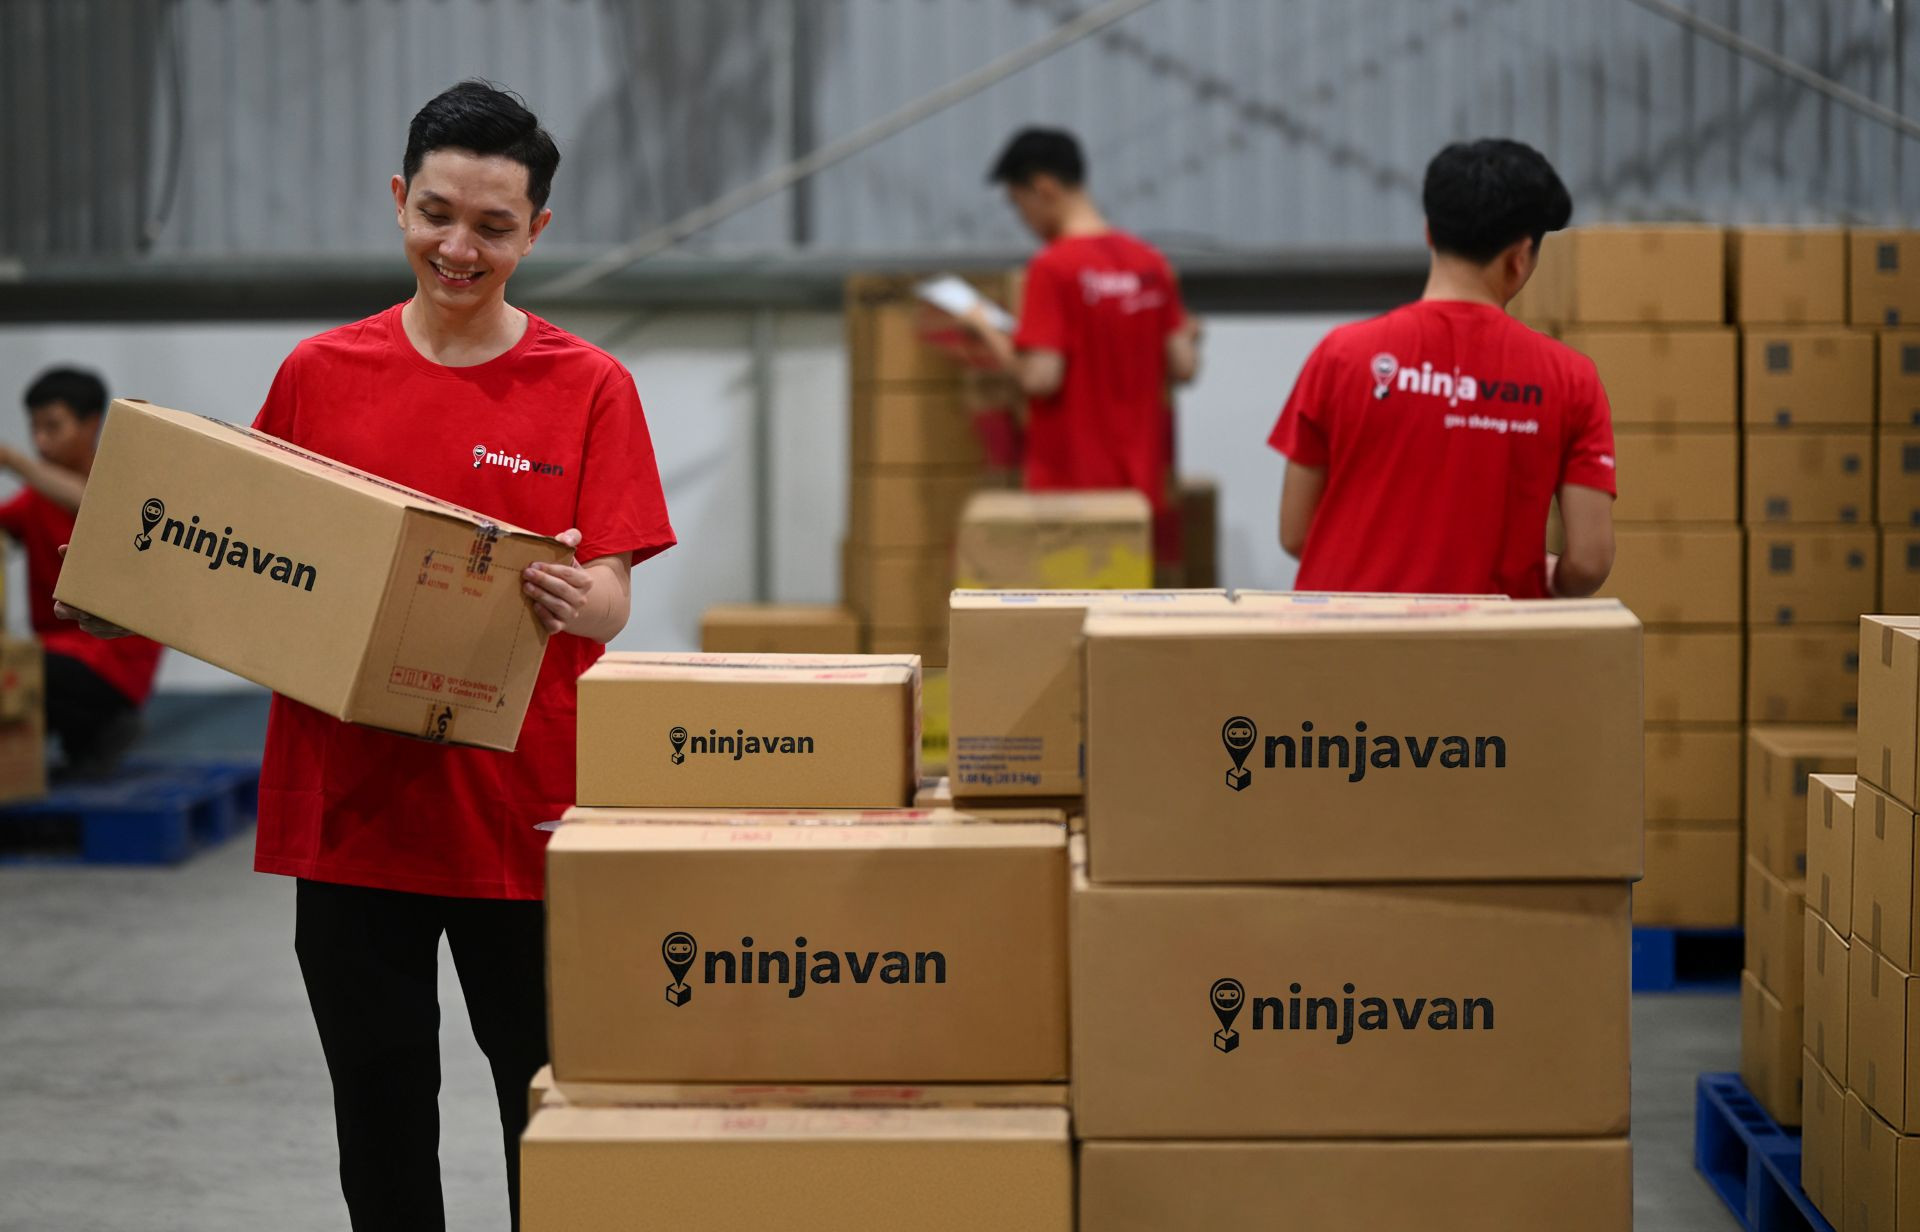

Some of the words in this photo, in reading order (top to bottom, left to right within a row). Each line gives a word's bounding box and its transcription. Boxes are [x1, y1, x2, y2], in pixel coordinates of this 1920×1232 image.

[1397, 361, 1543, 407] ninjavan
[485, 450, 564, 476] ninjavan
[160, 515, 317, 592] ninjavan
[691, 729, 814, 761] ninjavan
[1264, 720, 1506, 783] ninjavan
[704, 936, 946, 999] ninjavan
[1252, 982, 1494, 1045] ninjavan
